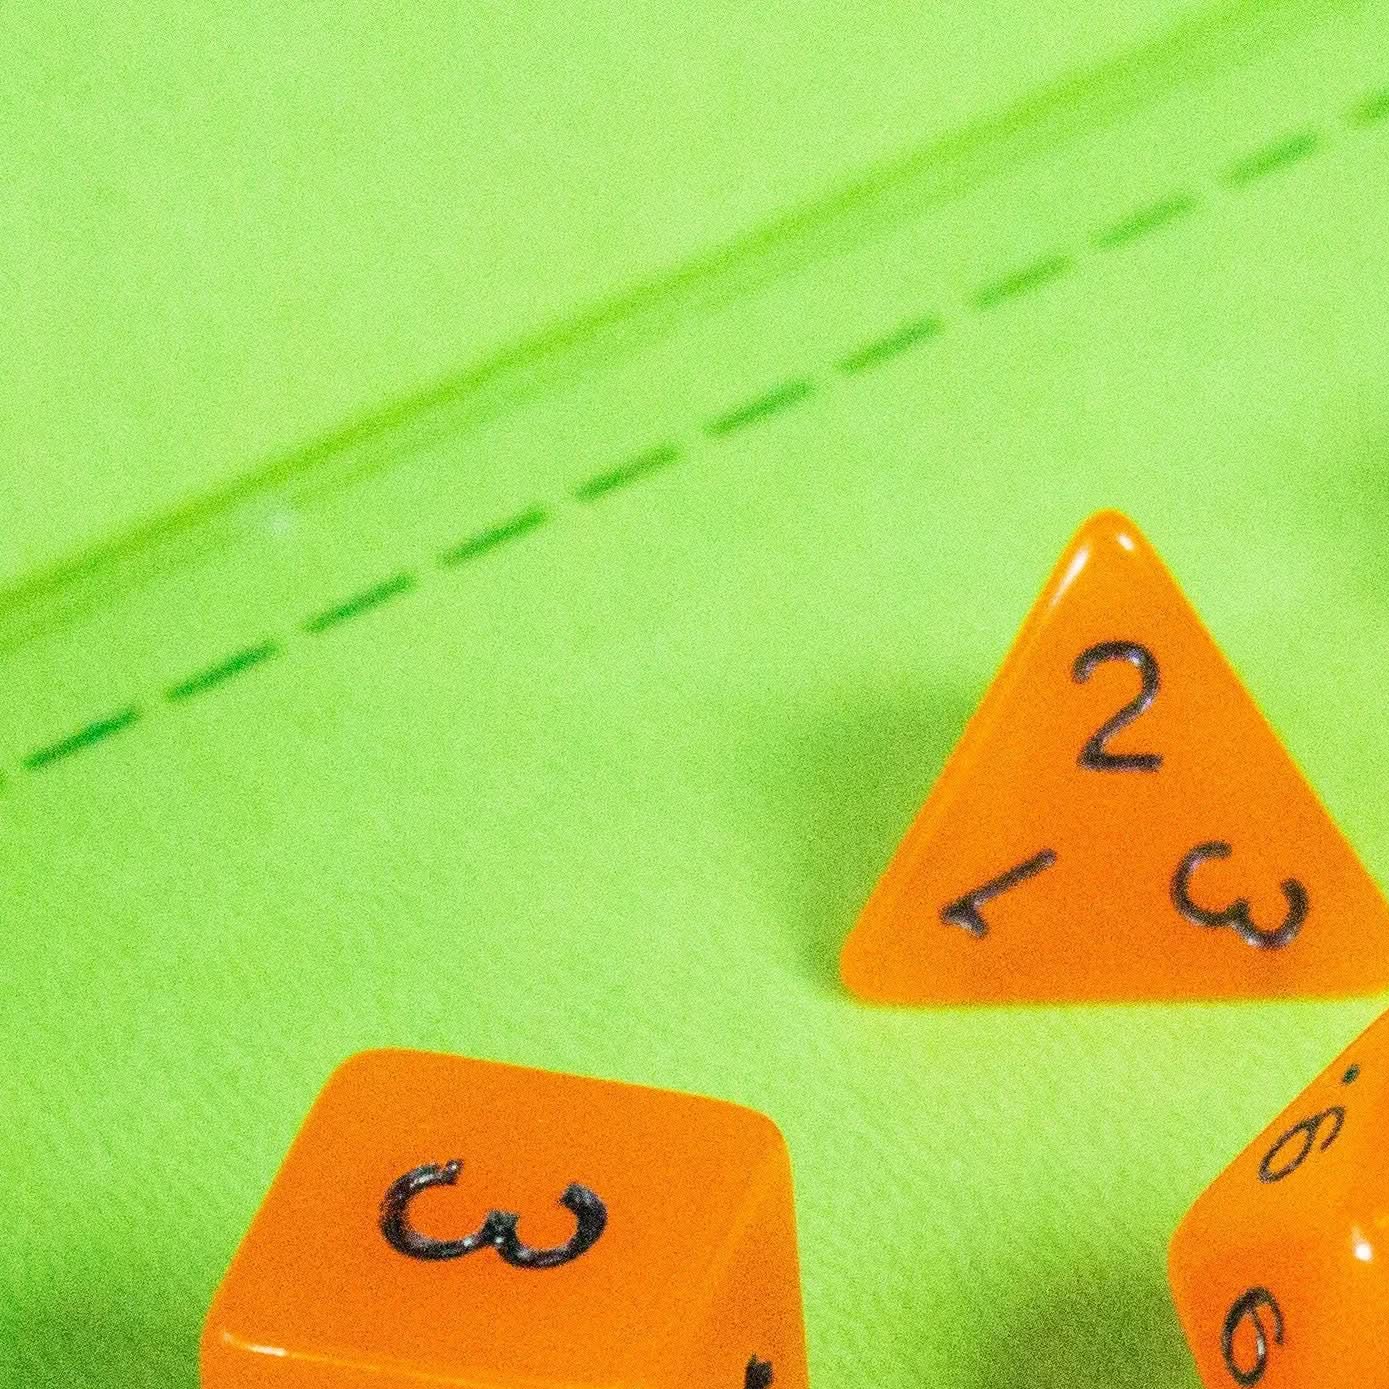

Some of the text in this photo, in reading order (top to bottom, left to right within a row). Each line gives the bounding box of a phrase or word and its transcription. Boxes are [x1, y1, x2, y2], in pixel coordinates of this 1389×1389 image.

[1070, 640, 1164, 772] 2
[938, 848, 1057, 939] 1
[1168, 840, 1310, 951] 3
[378, 1160, 610, 1270] 3
